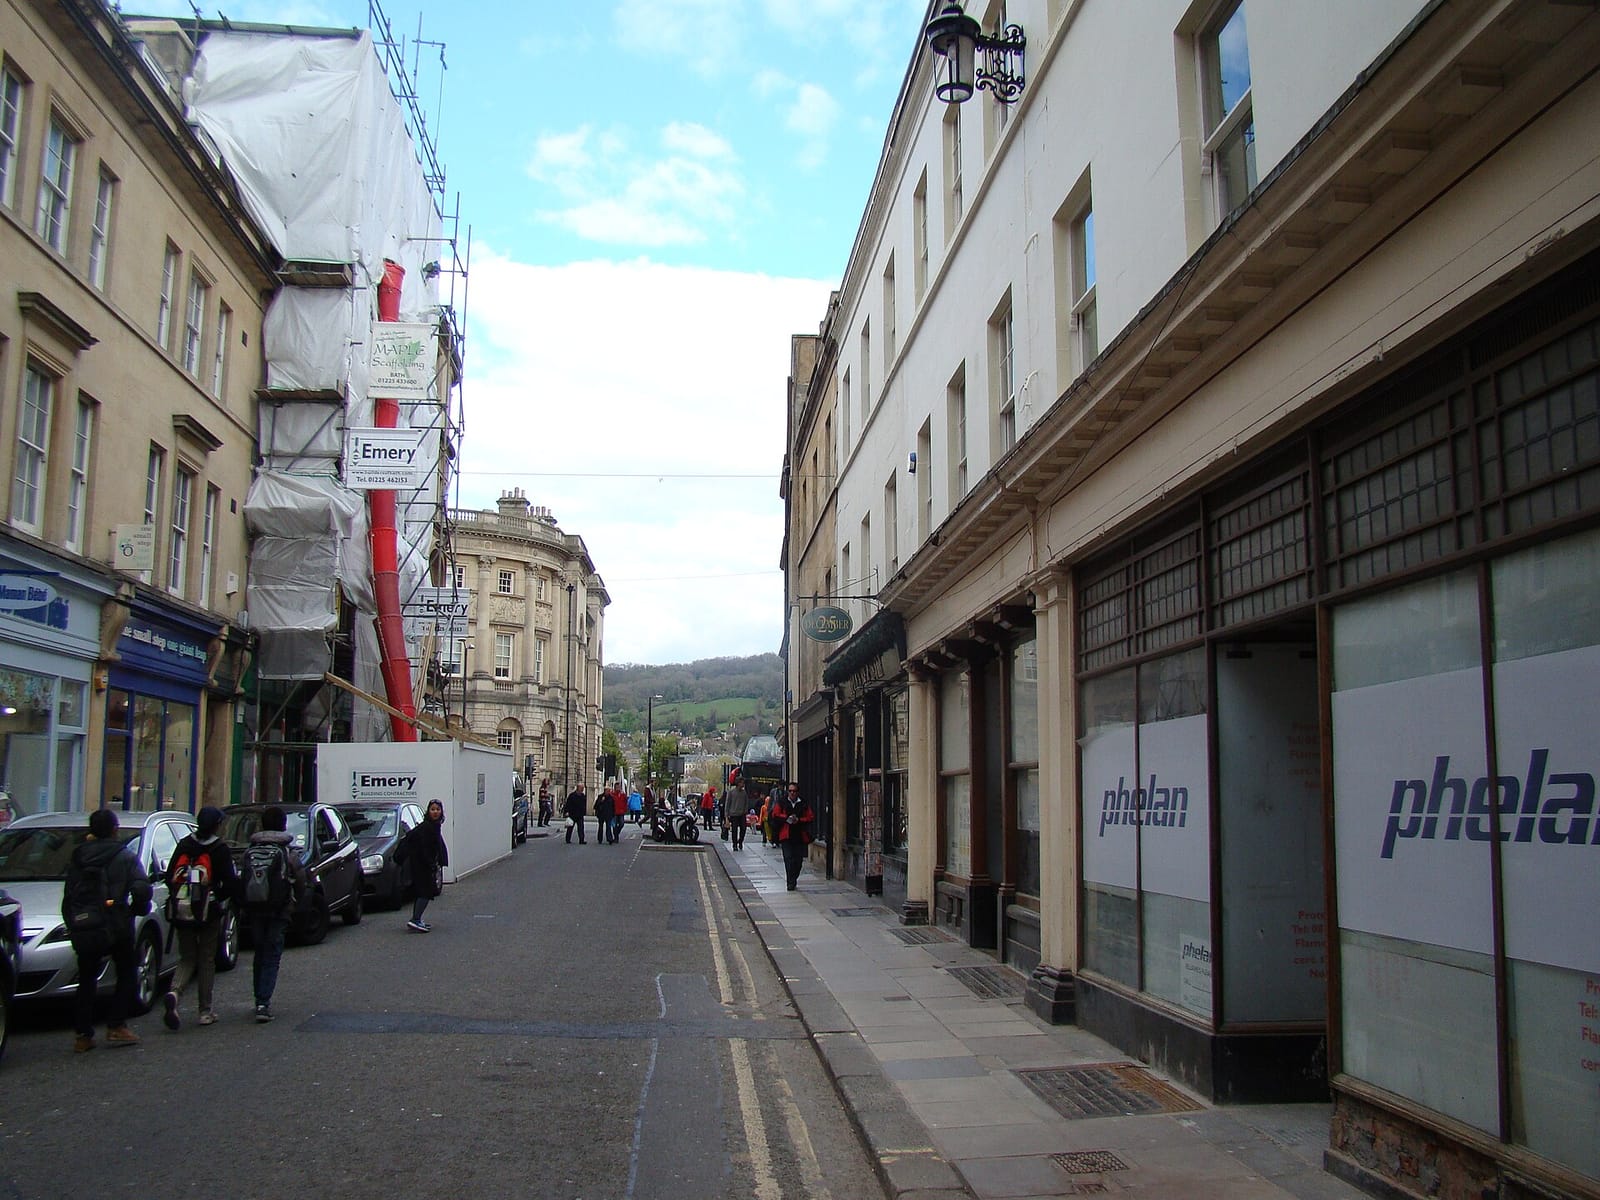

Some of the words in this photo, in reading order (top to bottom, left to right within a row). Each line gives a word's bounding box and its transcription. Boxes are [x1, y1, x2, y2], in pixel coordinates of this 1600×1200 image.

[373, 343, 426, 356] MAPLE
[371, 356, 425, 371] Scaffolding
[362, 443, 416, 464] Emery
[368, 476, 386, 484] 01225
[386, 476, 408, 484] 462153
[132, 629, 152, 644] small
[152, 633, 167, 652] step
[360, 775, 417, 791] Emery
[1099, 774, 1188, 837] phelan
[1380, 748, 1600, 859] phela
[1578, 1001, 1598, 1018] Tel:
